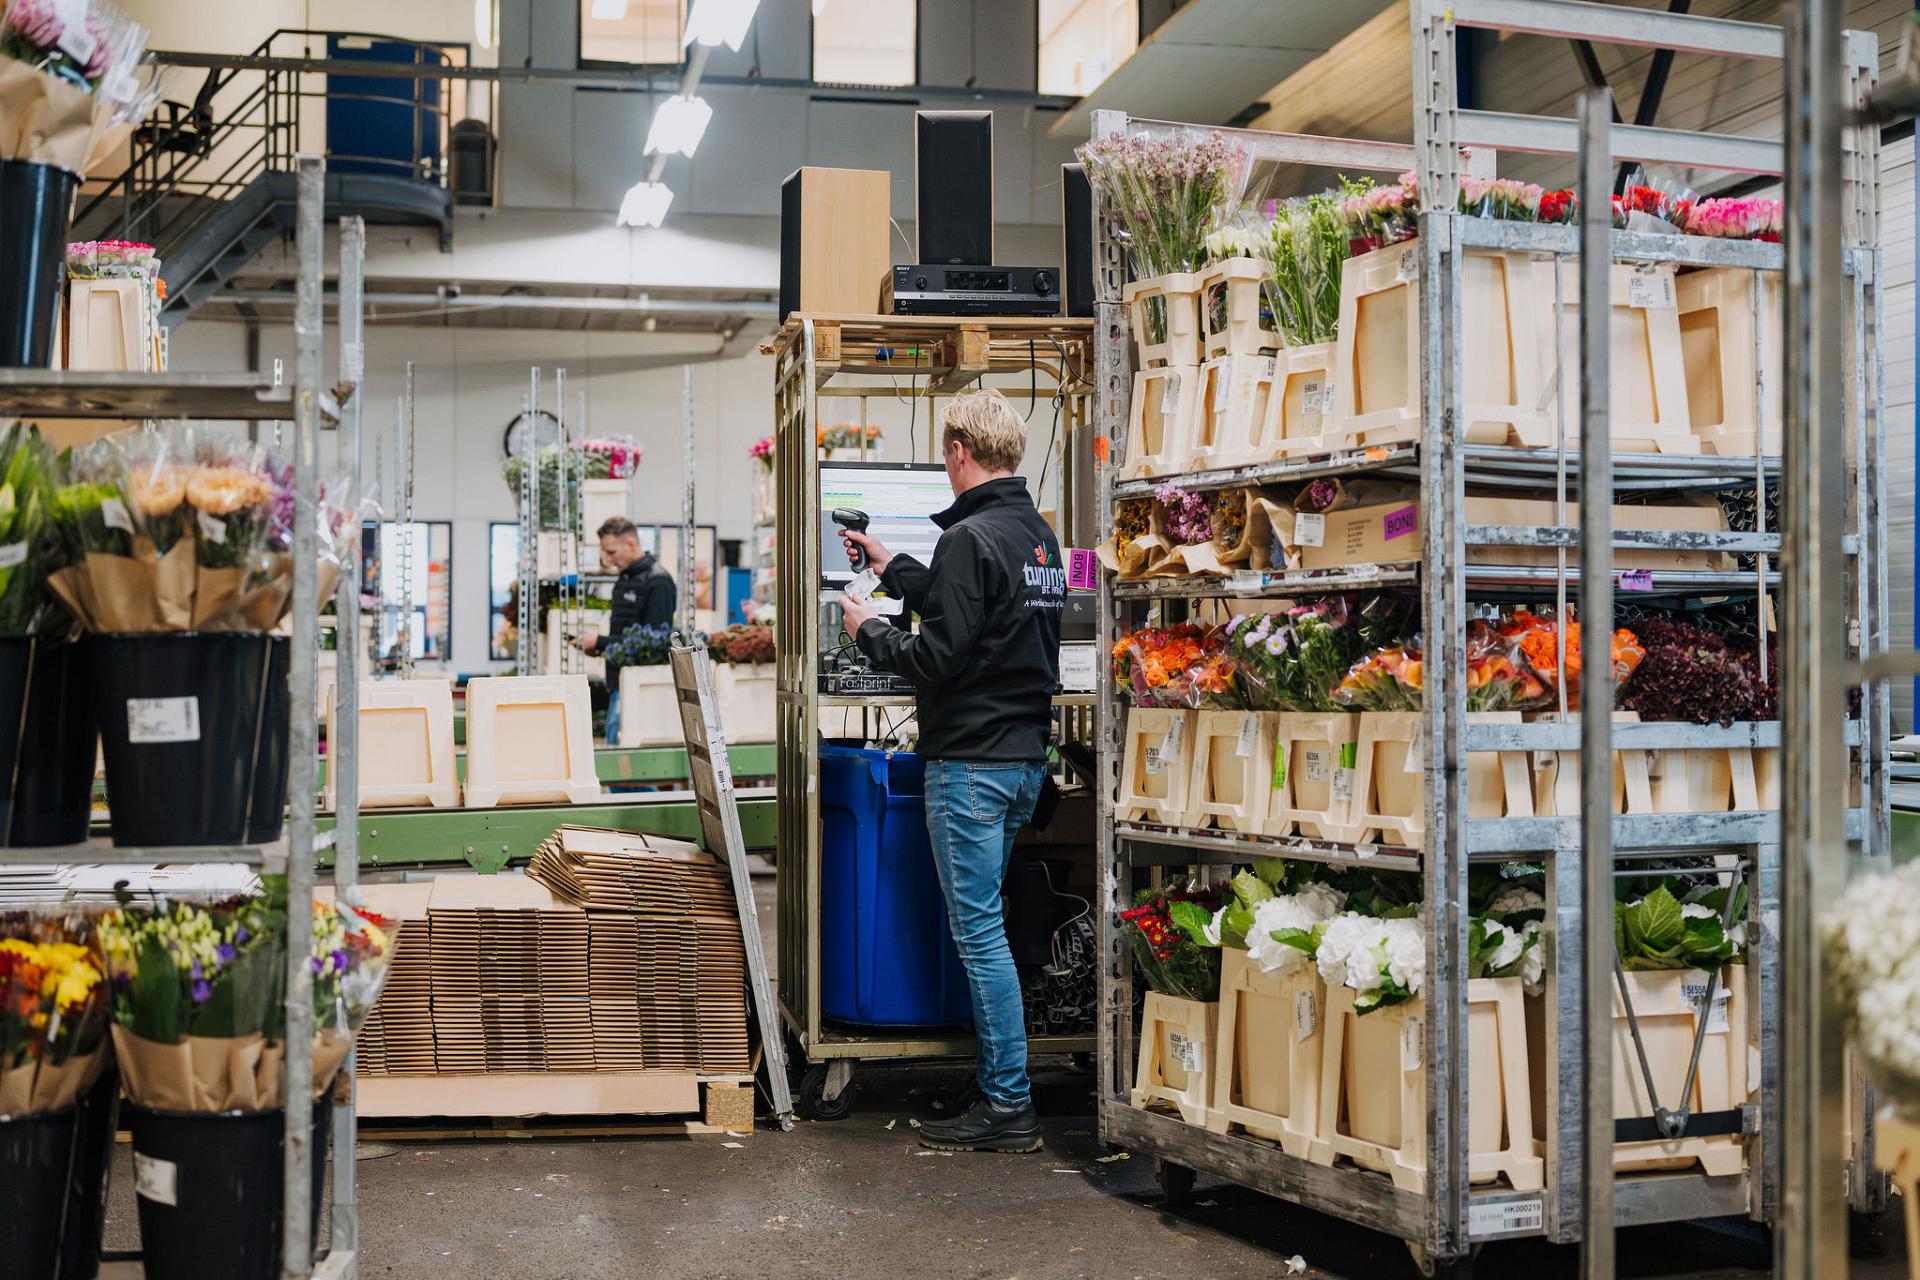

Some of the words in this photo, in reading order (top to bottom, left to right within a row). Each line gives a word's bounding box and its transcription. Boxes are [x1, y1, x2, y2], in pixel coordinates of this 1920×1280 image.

[1387, 513, 1414, 535] BONI
[1023, 562, 1064, 595] tuning
[1073, 554, 1083, 582] BONI
[839, 677, 892, 690] Fastprint
[1504, 1203, 1541, 1214] HK000219
